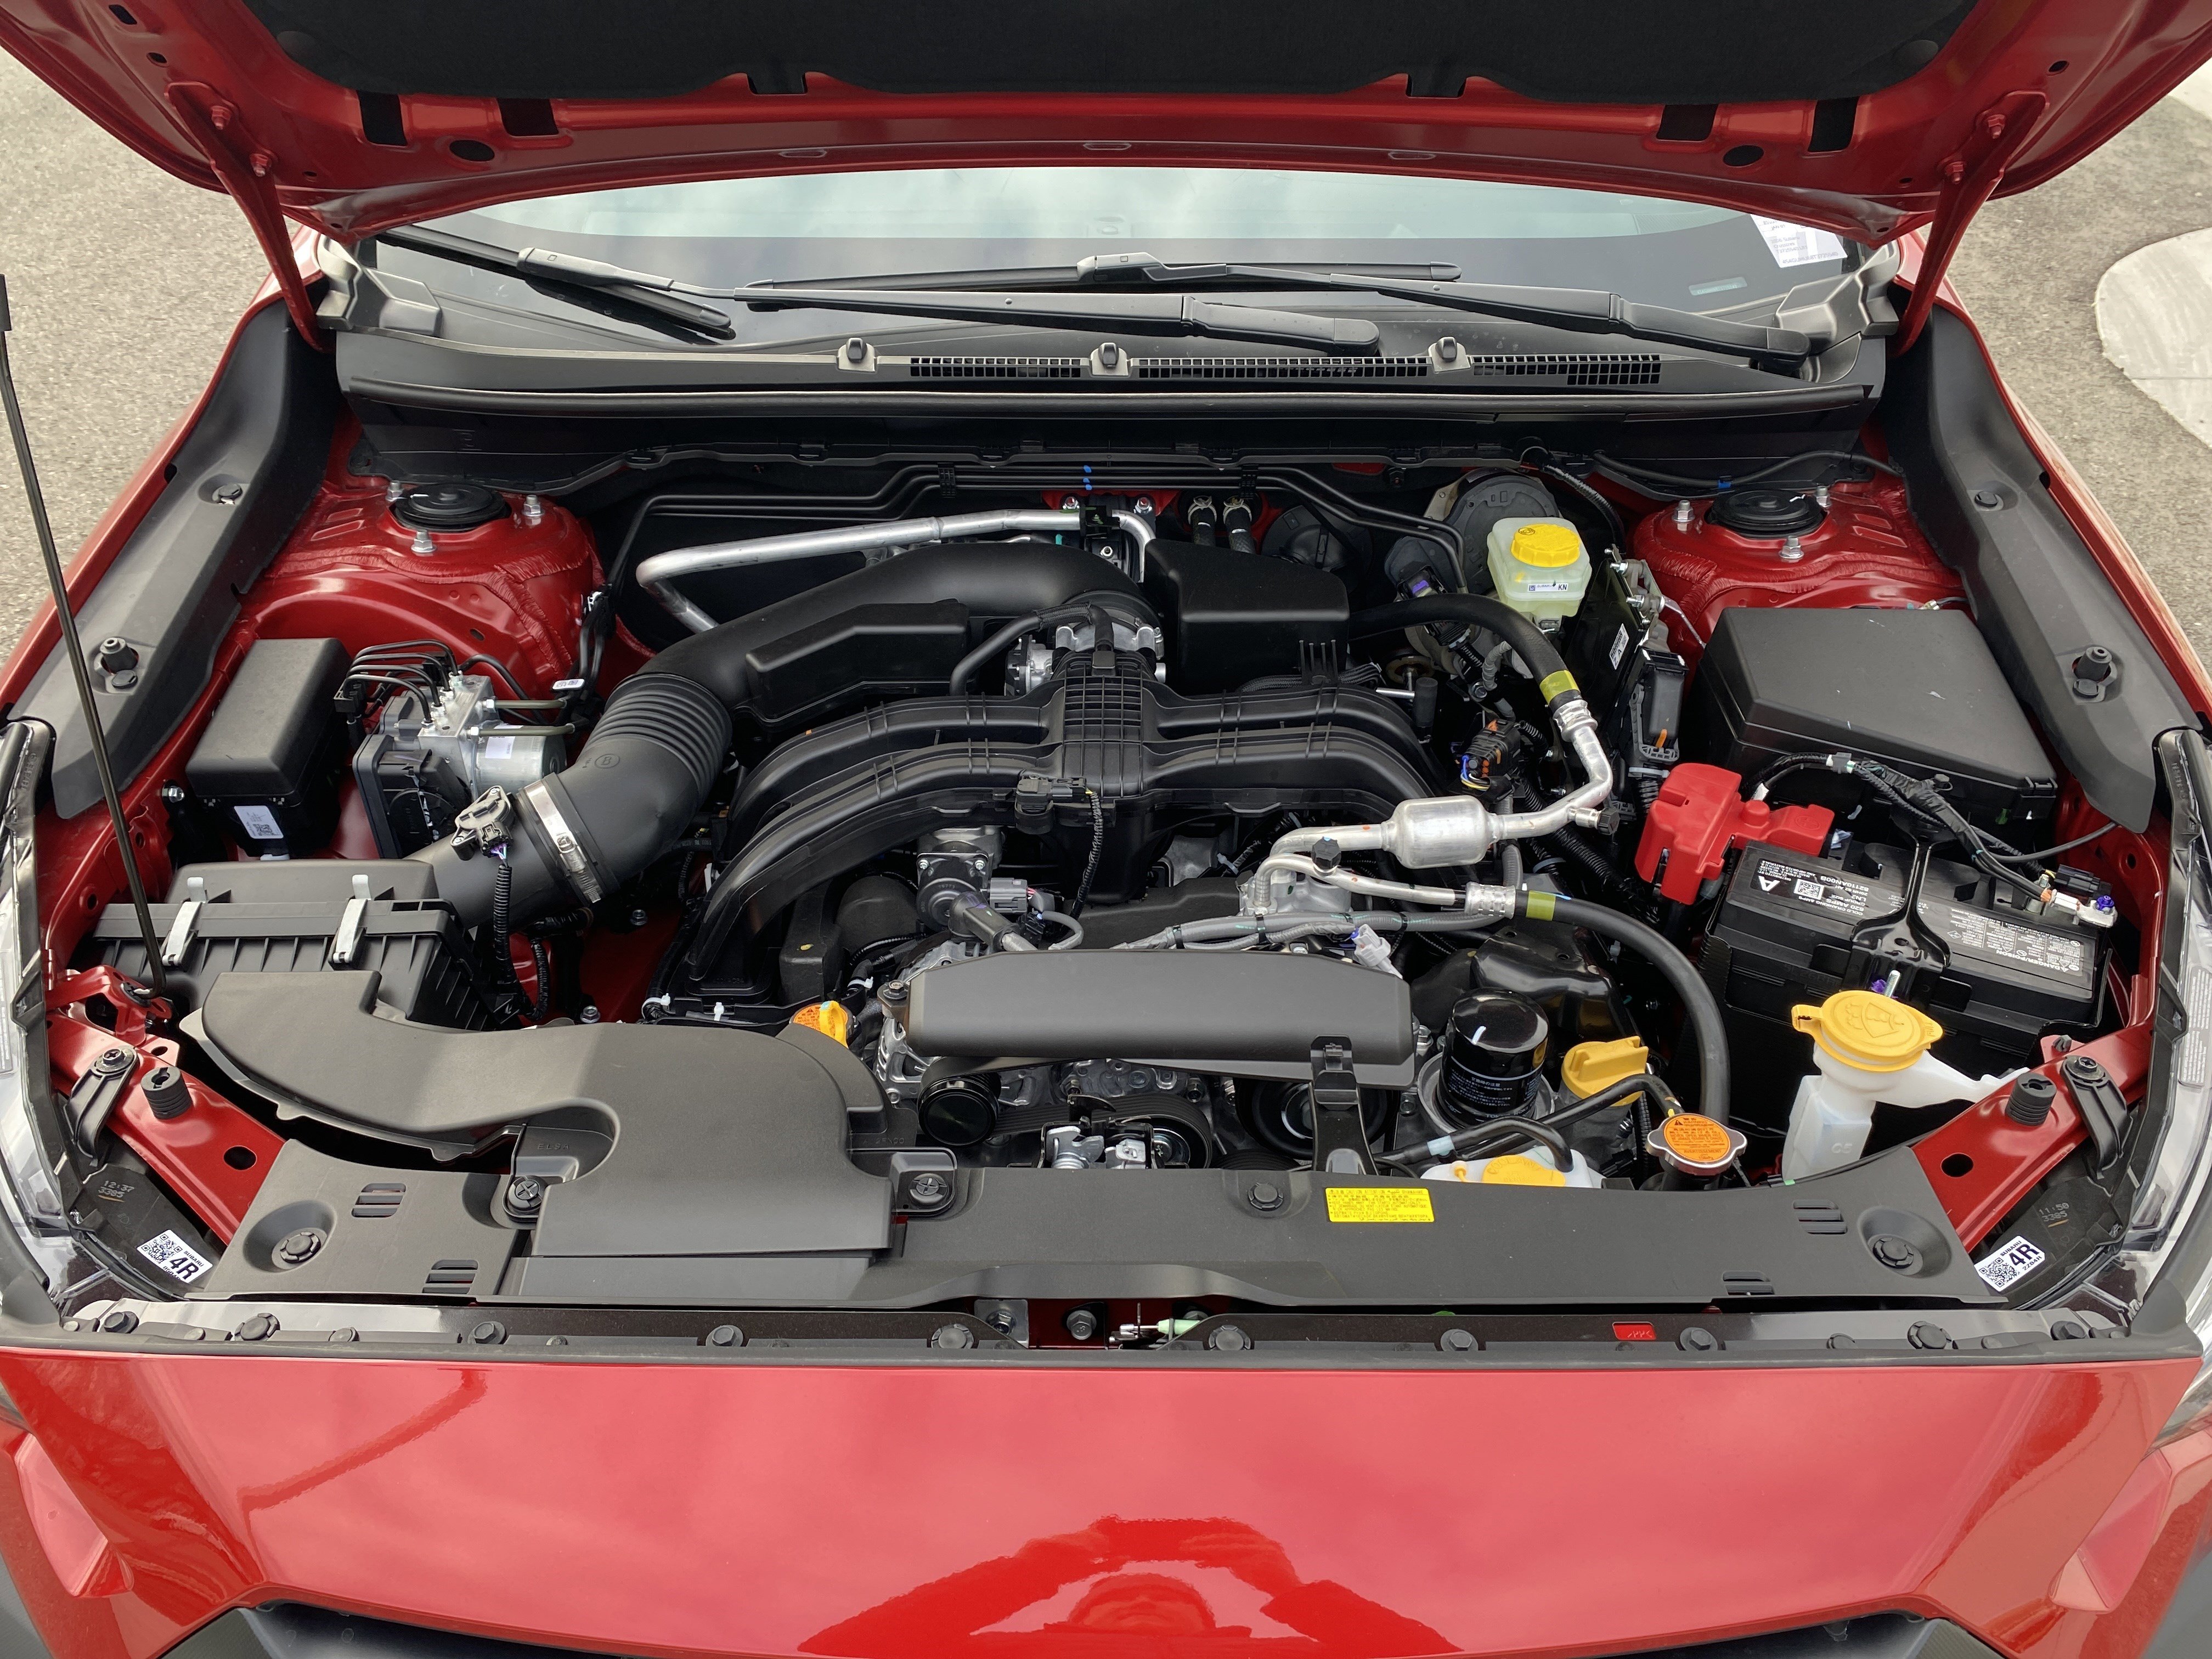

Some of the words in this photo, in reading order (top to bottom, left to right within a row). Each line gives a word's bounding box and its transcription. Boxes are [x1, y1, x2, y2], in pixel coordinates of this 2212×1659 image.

[1815, 900, 1846, 911] CRANKING
[1826, 898, 1849, 907] AMPS
[1844, 898, 1866, 906] GROUP
[1996, 949, 2061, 970] DANGER/POISON
[104, 1180, 136, 1193] 12:37
[2039, 1202, 2070, 1215] 11:50
[2000, 1240, 2022, 1257] SUBARU
[2008, 1244, 2040, 1266] 4R
[183, 1250, 205, 1267] SUBARU
[170, 1257, 200, 1280] 4R
